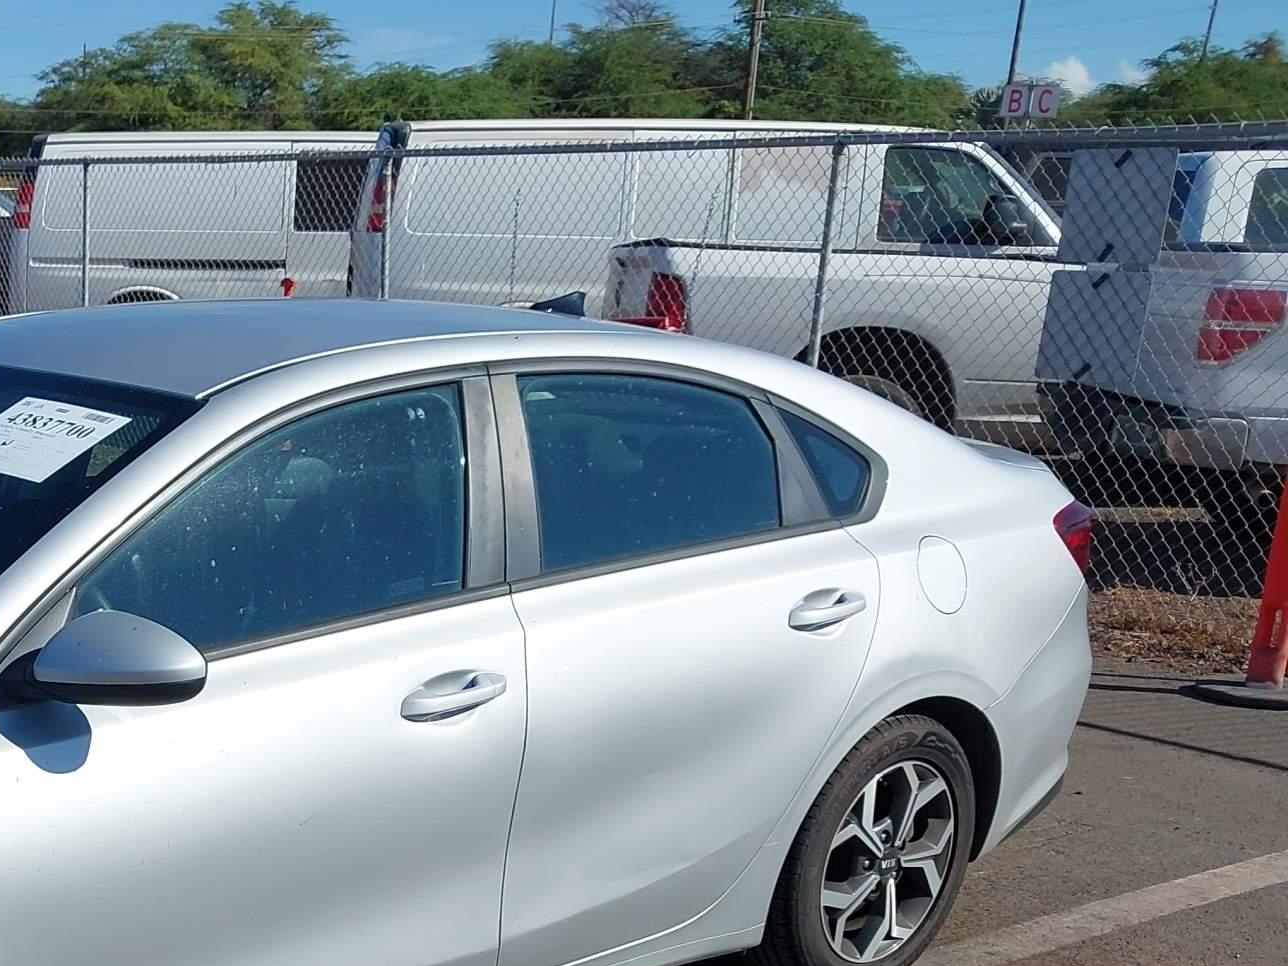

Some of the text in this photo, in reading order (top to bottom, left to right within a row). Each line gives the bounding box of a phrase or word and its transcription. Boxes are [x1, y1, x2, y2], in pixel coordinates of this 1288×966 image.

[1007, 89, 1024, 113] B
[1038, 89, 1054, 113] C
[6, 412, 96, 439] 43837700
